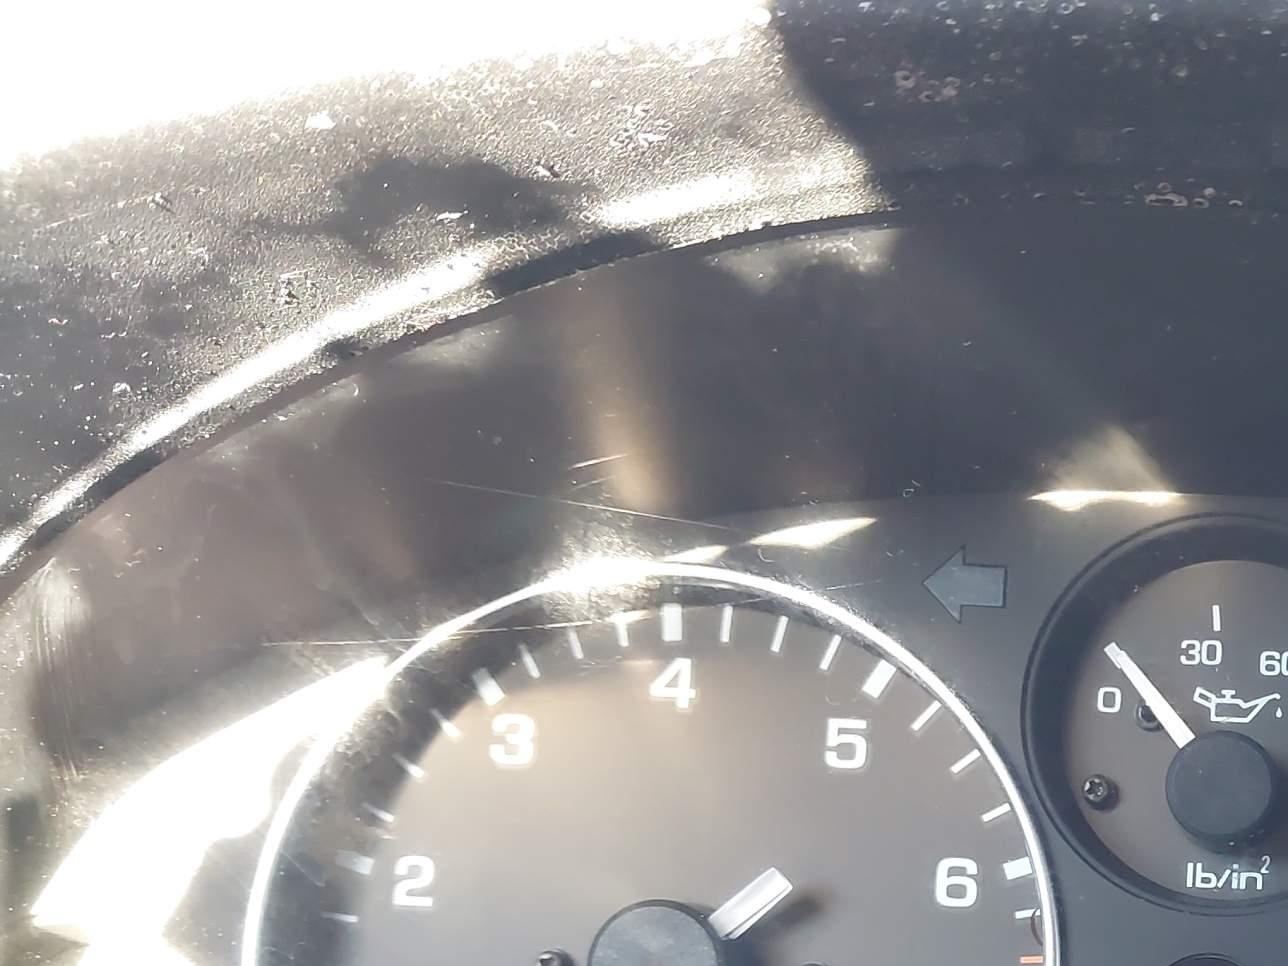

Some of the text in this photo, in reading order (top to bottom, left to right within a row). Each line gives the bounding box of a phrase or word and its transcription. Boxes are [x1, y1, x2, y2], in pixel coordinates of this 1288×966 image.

[1180, 640, 1222, 665] 30
[650, 658, 696, 708] 4
[1097, 687, 1121, 712] 0
[489, 714, 536, 765] 3
[825, 720, 867, 769] 5
[393, 857, 433, 908] 2
[936, 858, 978, 908] 6
